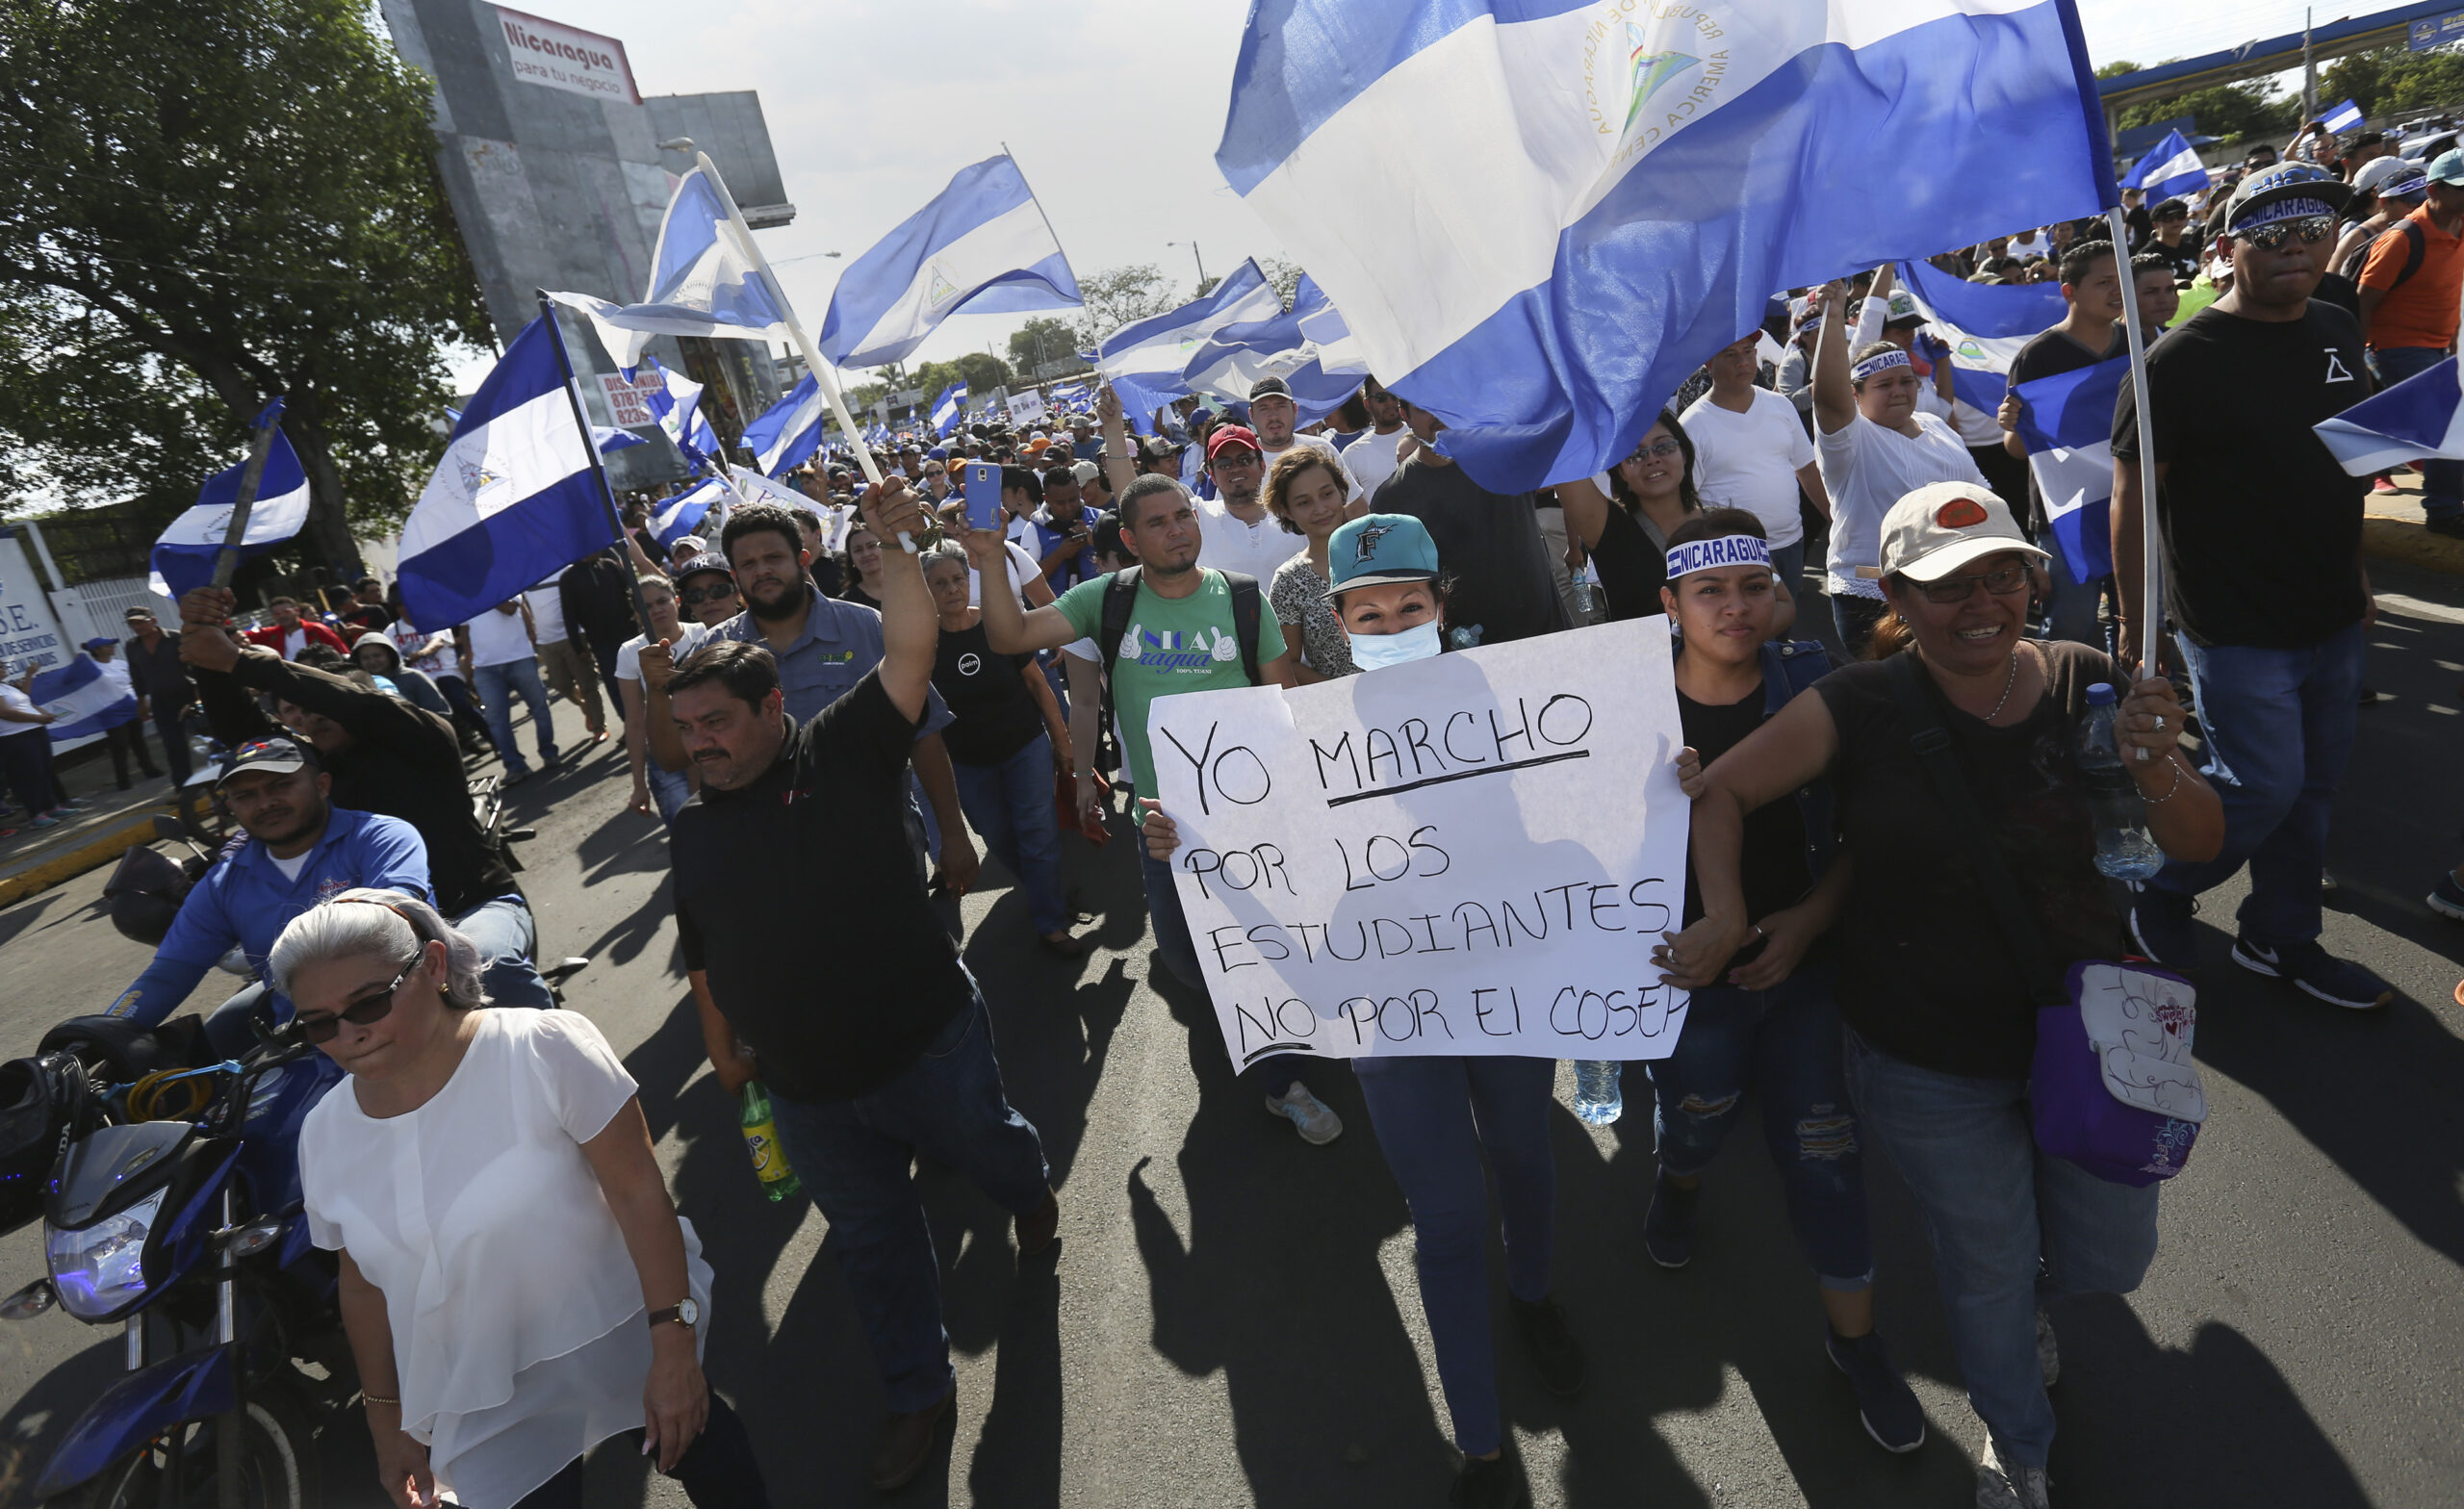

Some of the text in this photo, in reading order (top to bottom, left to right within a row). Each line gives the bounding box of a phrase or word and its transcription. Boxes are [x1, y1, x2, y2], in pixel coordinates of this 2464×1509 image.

[503, 21, 613, 70] Nicaragua
[514, 60, 621, 93] para tu negocio
[603, 373, 664, 392] DISONIBL
[1681, 538, 1763, 572] NICARAGUA
[1144, 629, 1210, 651] NICA
[1134, 652, 1212, 675] ragua
[1161, 694, 1593, 815] YO MARCHO
[1184, 825, 1450, 899] POR LOS
[1206, 878, 1671, 973] ESTUDIANTES
[1235, 997, 1317, 1054] NO
[1339, 988, 1454, 1045] POR
